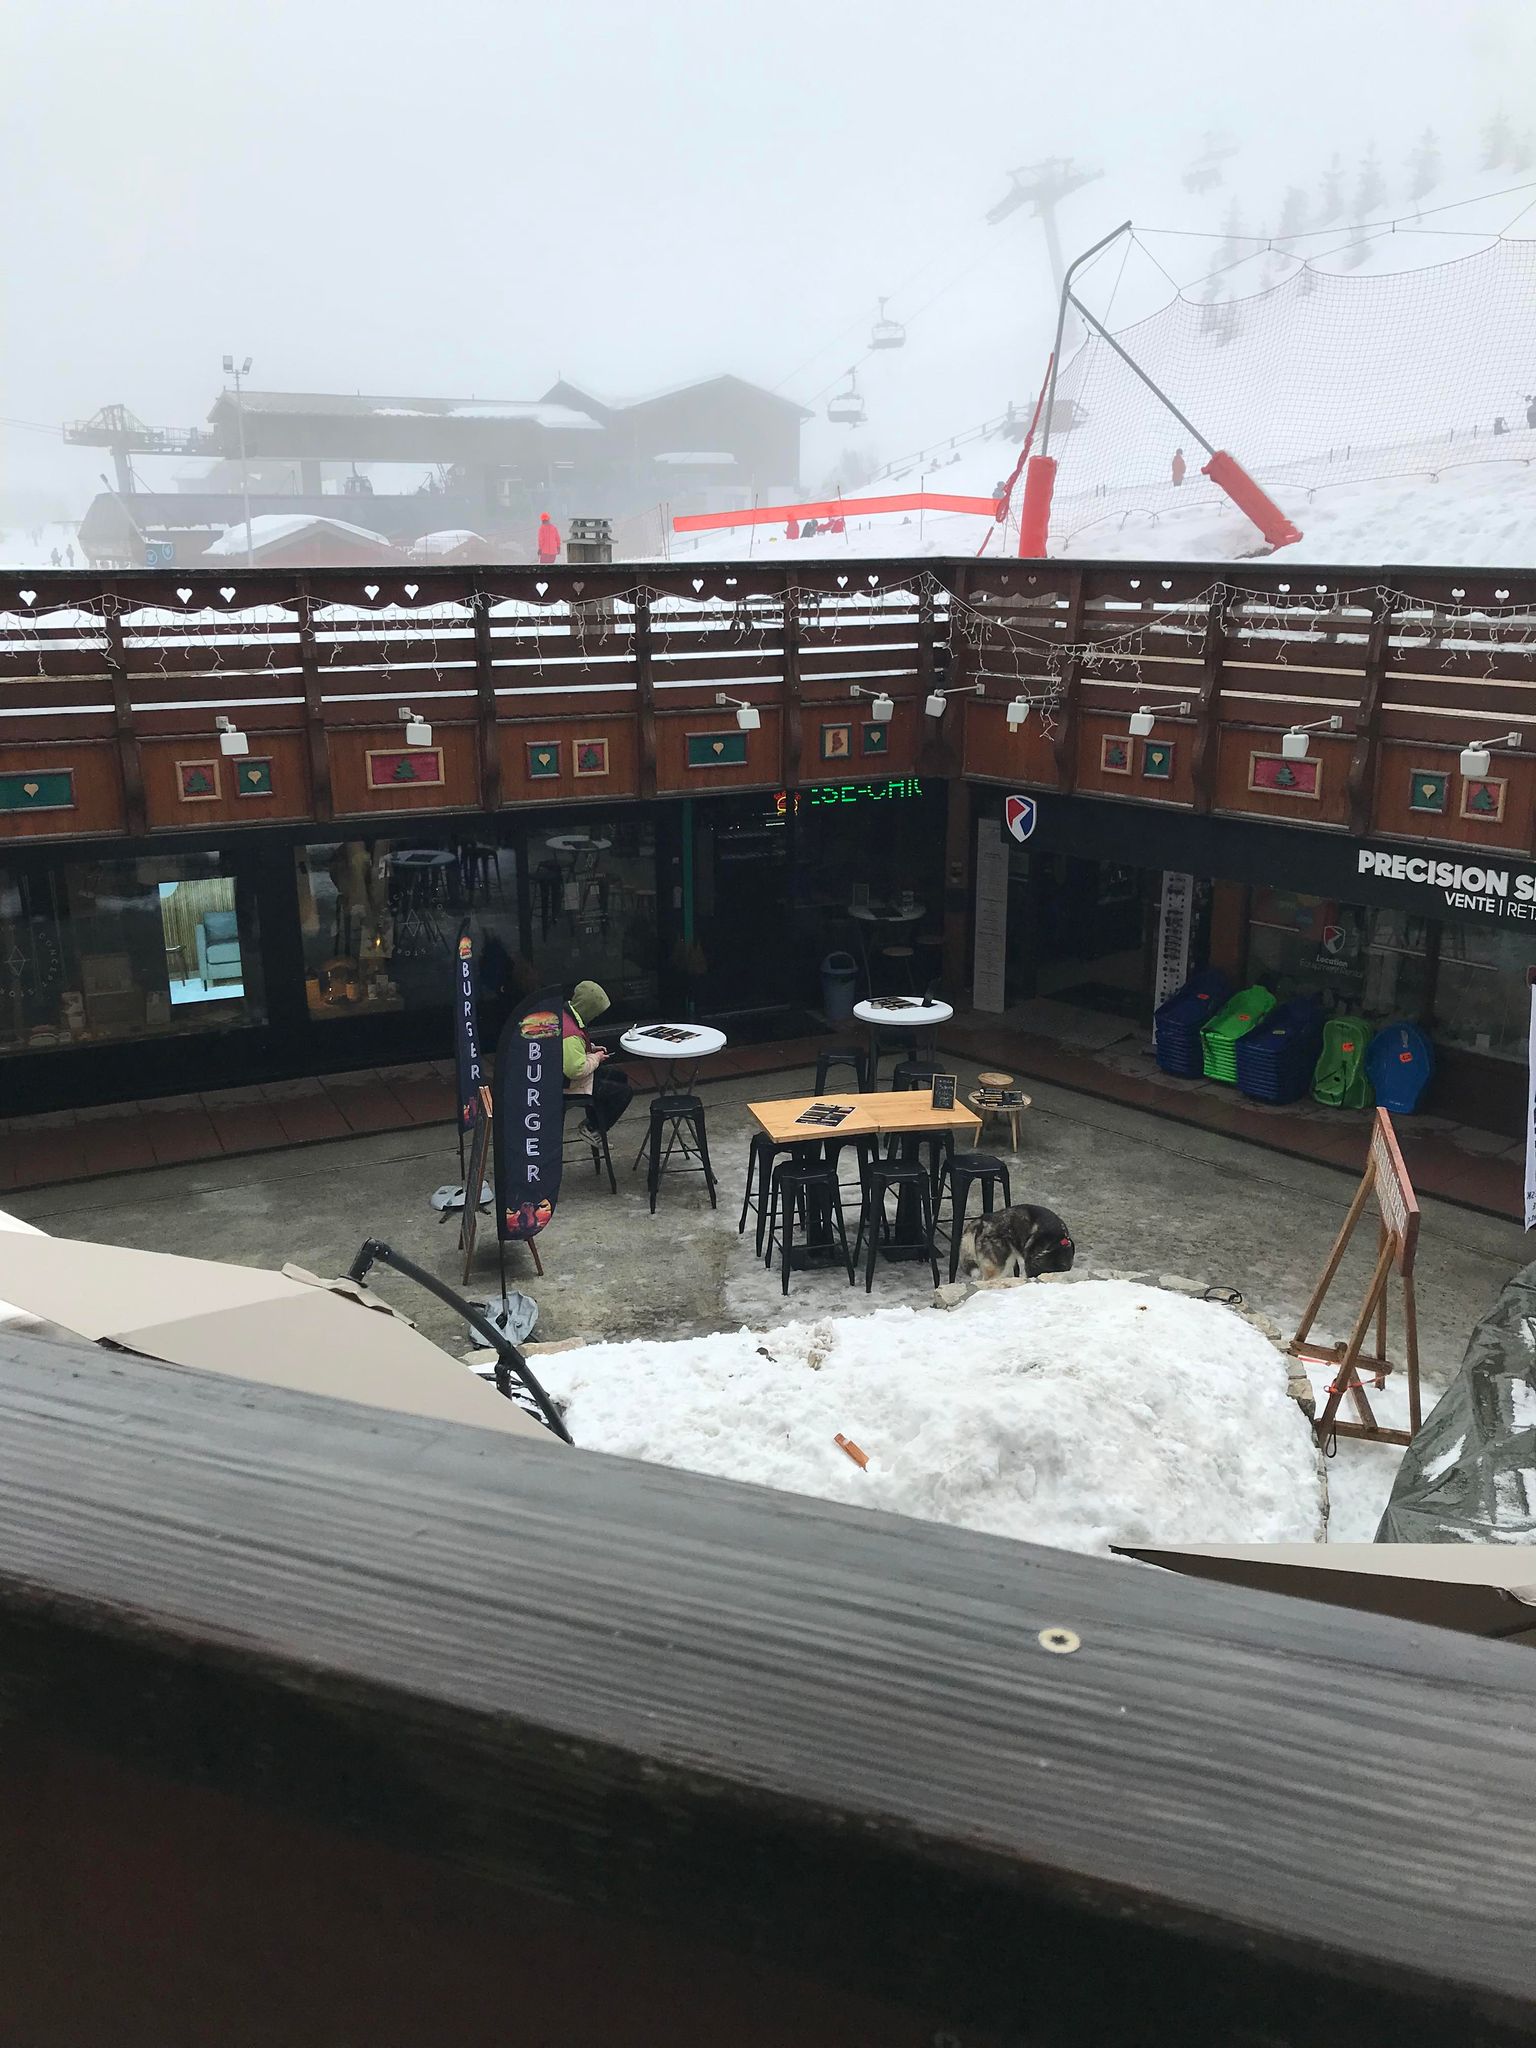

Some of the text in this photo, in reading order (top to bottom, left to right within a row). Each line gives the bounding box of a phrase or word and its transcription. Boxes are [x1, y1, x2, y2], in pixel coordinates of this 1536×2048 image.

[1358, 849, 1536, 902] PRECISION S
[1445, 891, 1536, 920] VENTE RET
[462, 961, 480, 1080] BURGER
[524, 1042, 542, 1183] BURGER
